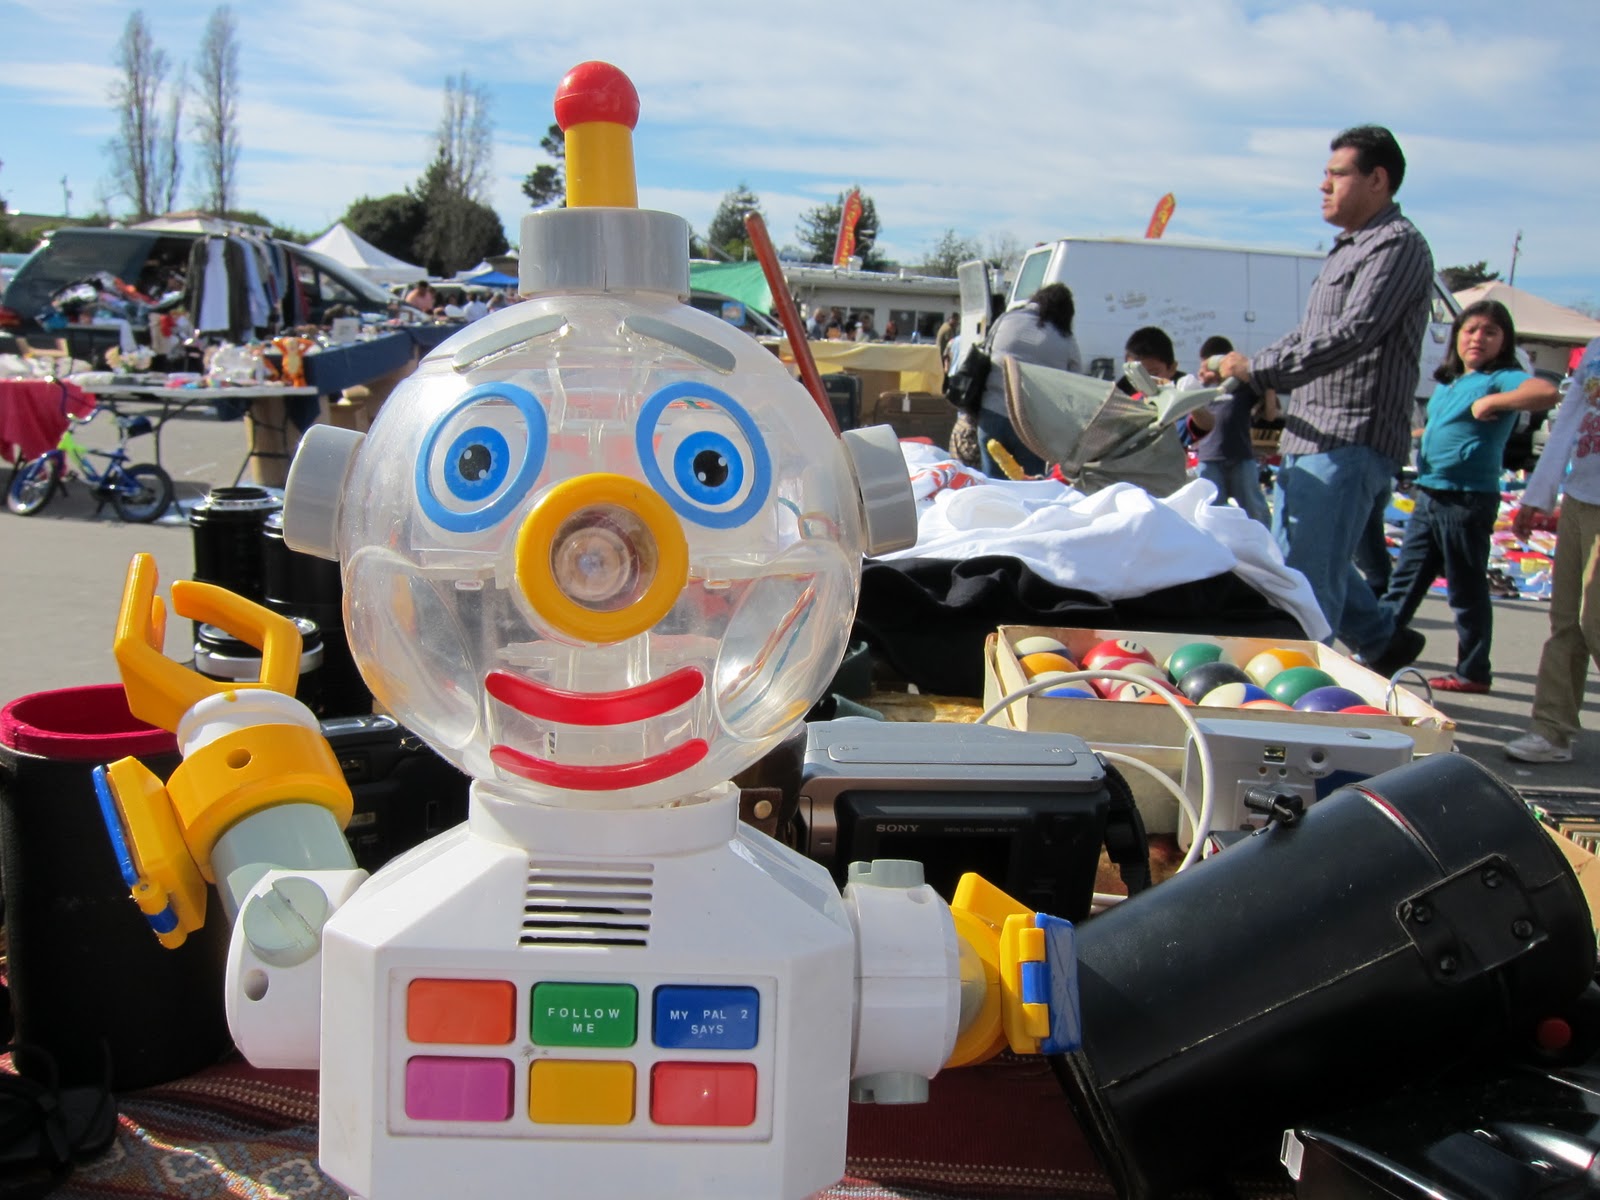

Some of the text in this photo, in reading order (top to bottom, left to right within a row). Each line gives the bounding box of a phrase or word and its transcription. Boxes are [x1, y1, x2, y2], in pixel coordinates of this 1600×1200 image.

[1124, 640, 1137, 650] 11
[876, 824, 919, 832] SONY
[548, 1007, 620, 1018] FOLLOW
[670, 1009, 748, 1020] MY PAL 2
[573, 1023, 595, 1033] ME
[691, 1025, 724, 1034] SAYS
